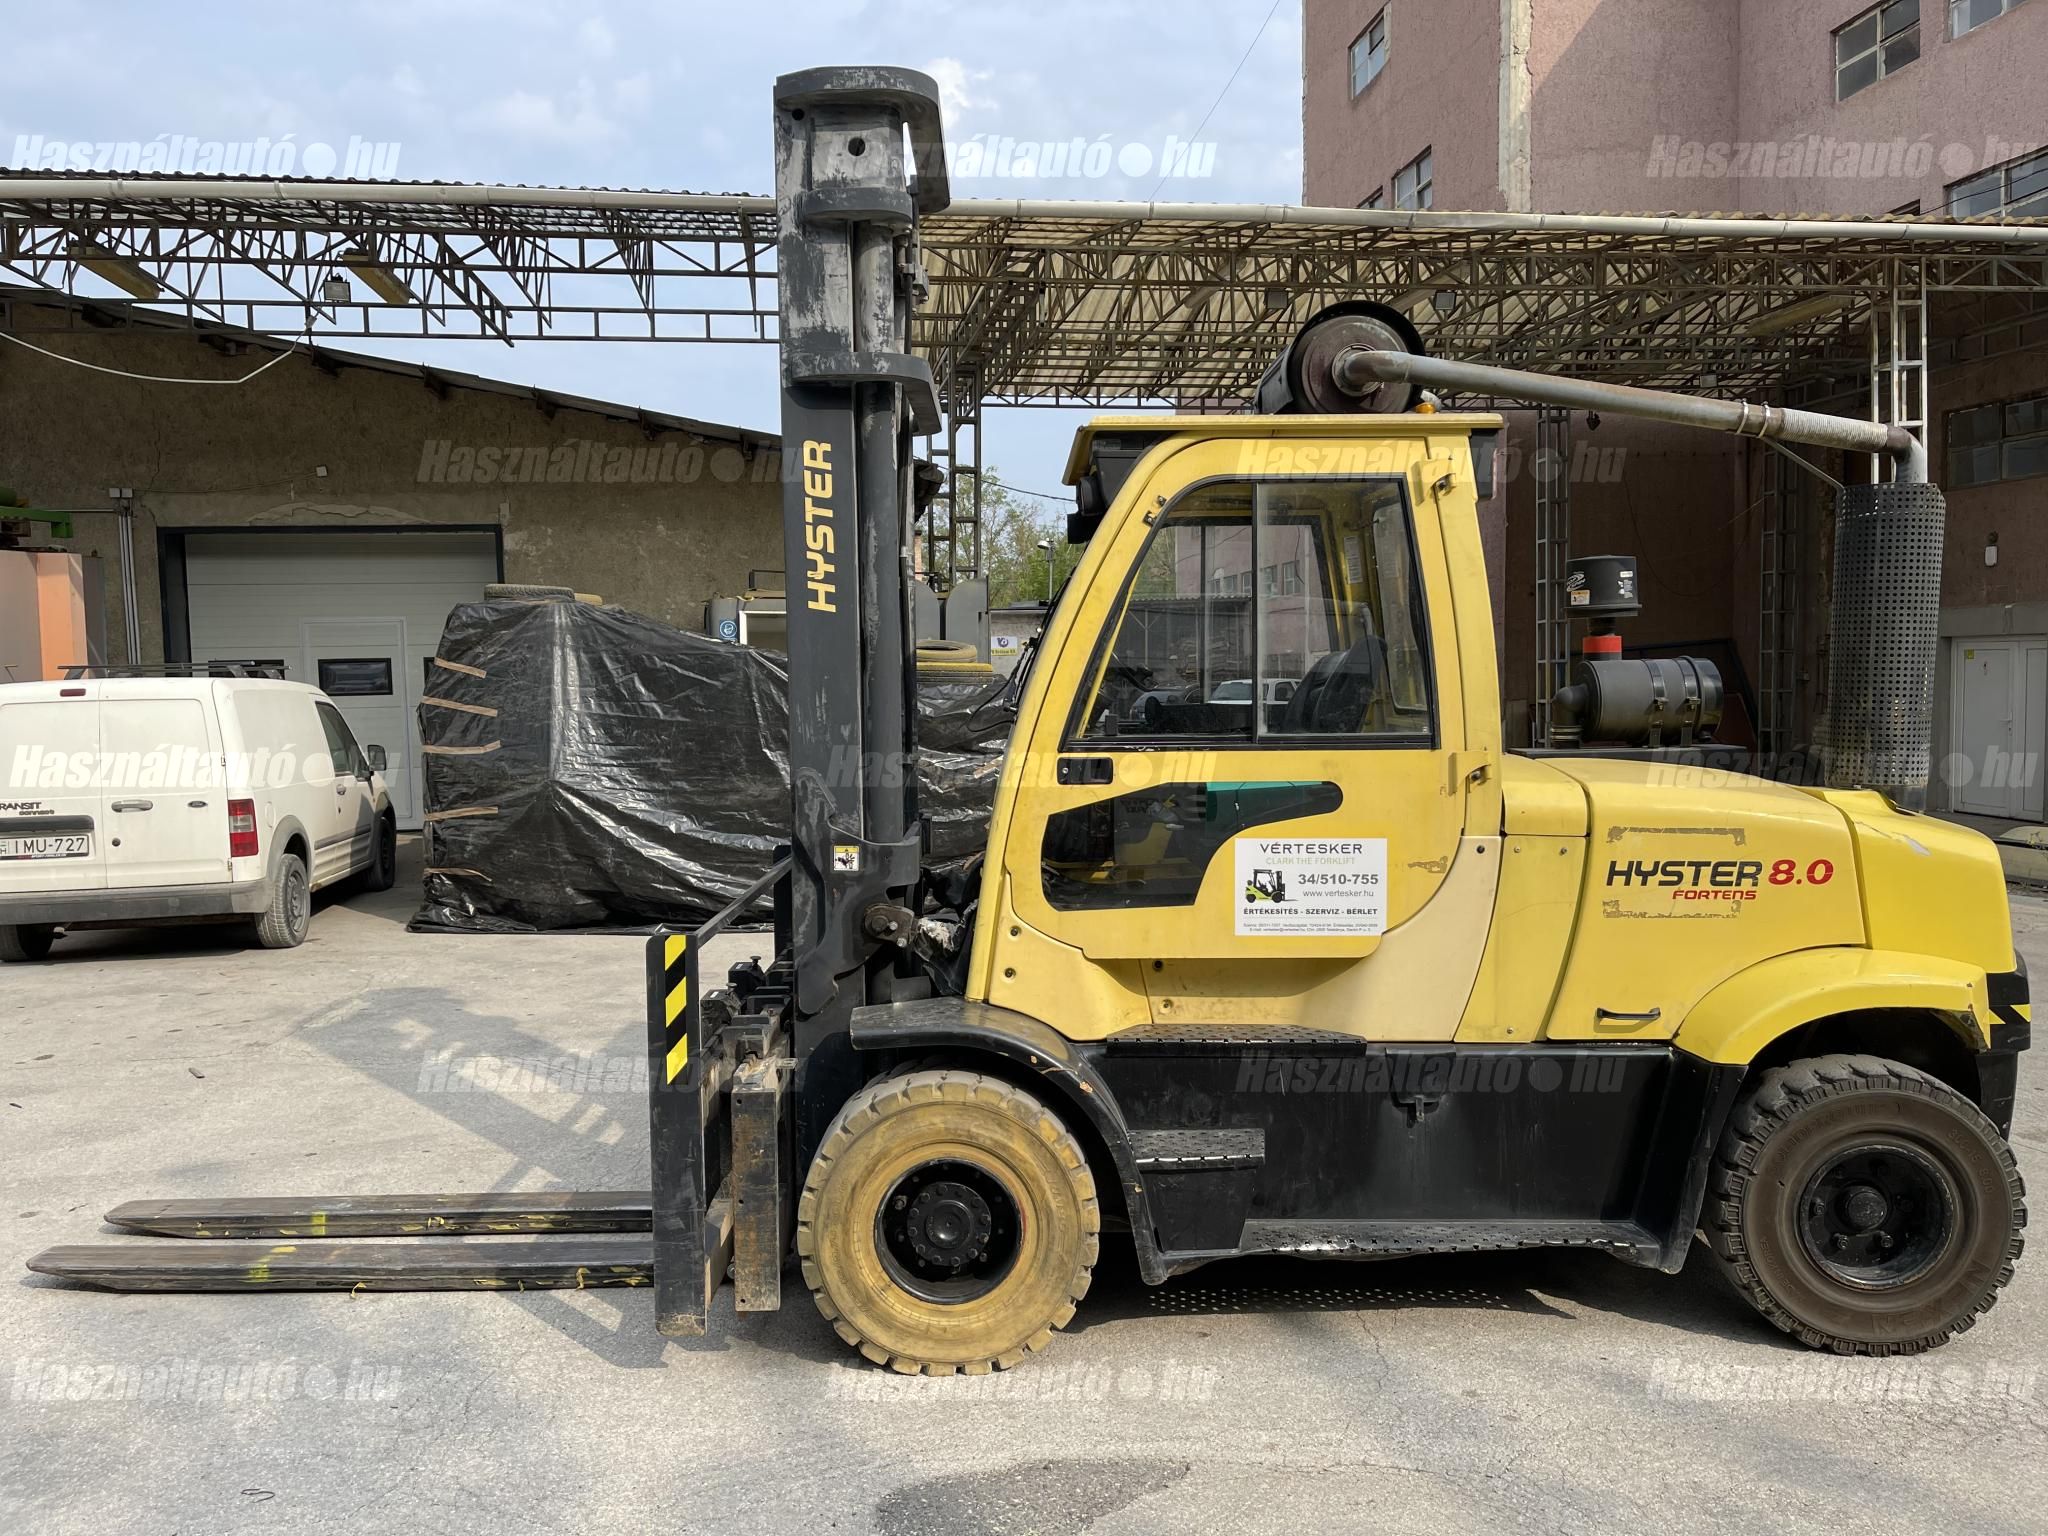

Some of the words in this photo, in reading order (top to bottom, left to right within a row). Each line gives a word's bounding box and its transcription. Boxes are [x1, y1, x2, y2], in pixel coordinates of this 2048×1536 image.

[803, 439, 836, 612] HYSTER
[0, 802, 42, 810] RANSIT
[1260, 842, 1363, 854] VÉRTESKER
[1266, 857, 1295, 865] CLARK
[1296, 857, 1312, 865] THE
[1315, 857, 1356, 865] FORKLIFT
[1605, 860, 1763, 887] HYSTER
[1767, 859, 1834, 886] 8.0
[1298, 874, 1379, 885] 34/510-755
[1303, 889, 1374, 898] www.vertesker.hu
[1671, 890, 1757, 900] FORTENS
